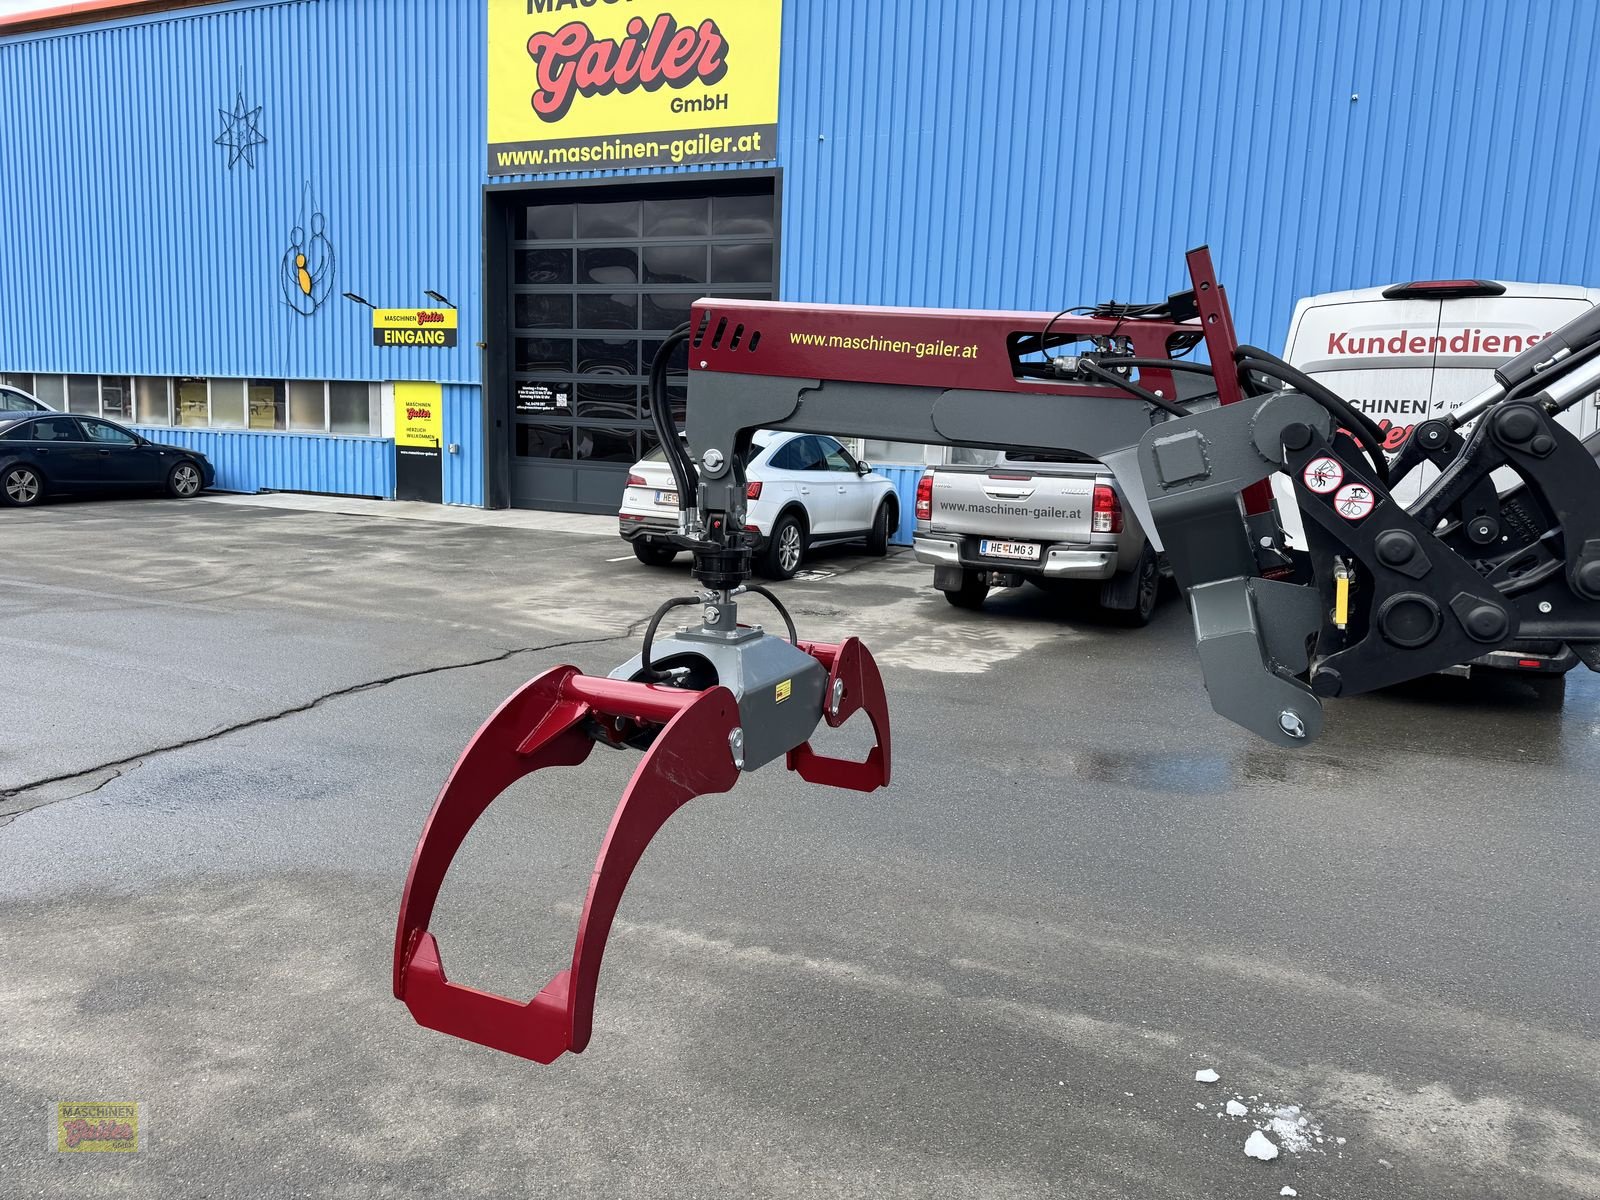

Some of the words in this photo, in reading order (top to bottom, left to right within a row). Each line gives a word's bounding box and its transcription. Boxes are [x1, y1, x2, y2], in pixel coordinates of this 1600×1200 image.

[527, 12, 729, 123] Gailer
[670, 94, 728, 113] GmbH
[497, 132, 761, 166] www.maschinen-gailer.at
[384, 330, 445, 344] EINGANG
[790, 332, 978, 359] www.maschinen-gailer.at
[1327, 329, 1553, 354] Kundendiens
[1348, 399, 1427, 414] CHINEN
[940, 501, 1081, 519] www.maschinen-gailer.at
[990, 543, 1002, 553] HE
[1008, 544, 1026, 555] LMG
[1027, 546, 1034, 555] 3
